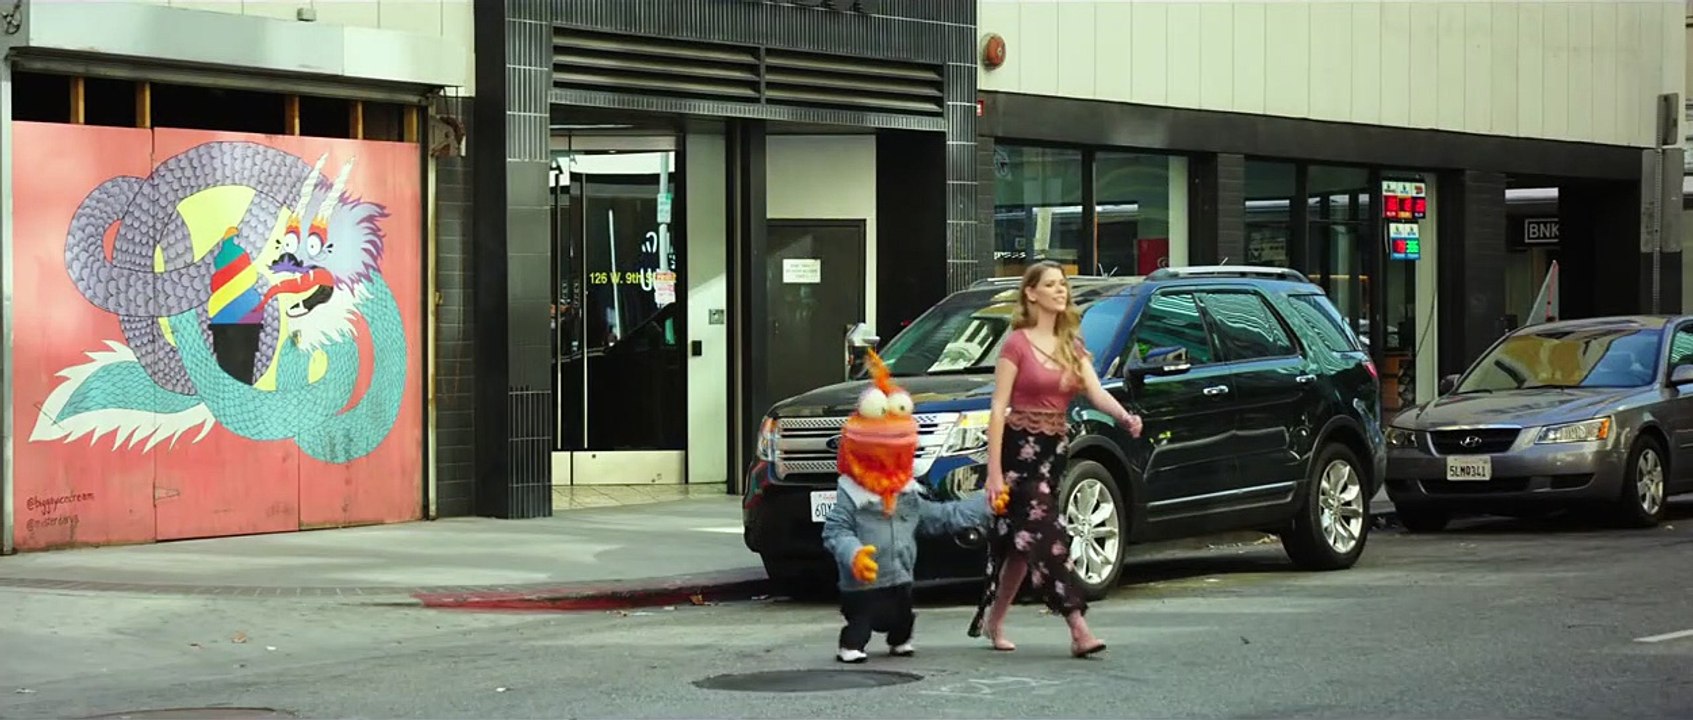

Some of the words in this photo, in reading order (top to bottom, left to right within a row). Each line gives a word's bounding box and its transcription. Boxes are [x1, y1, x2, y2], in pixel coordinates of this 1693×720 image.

[589, 272, 608, 284] 126
[609, 272, 624, 284] W.
[625, 272, 642, 284] 9th
